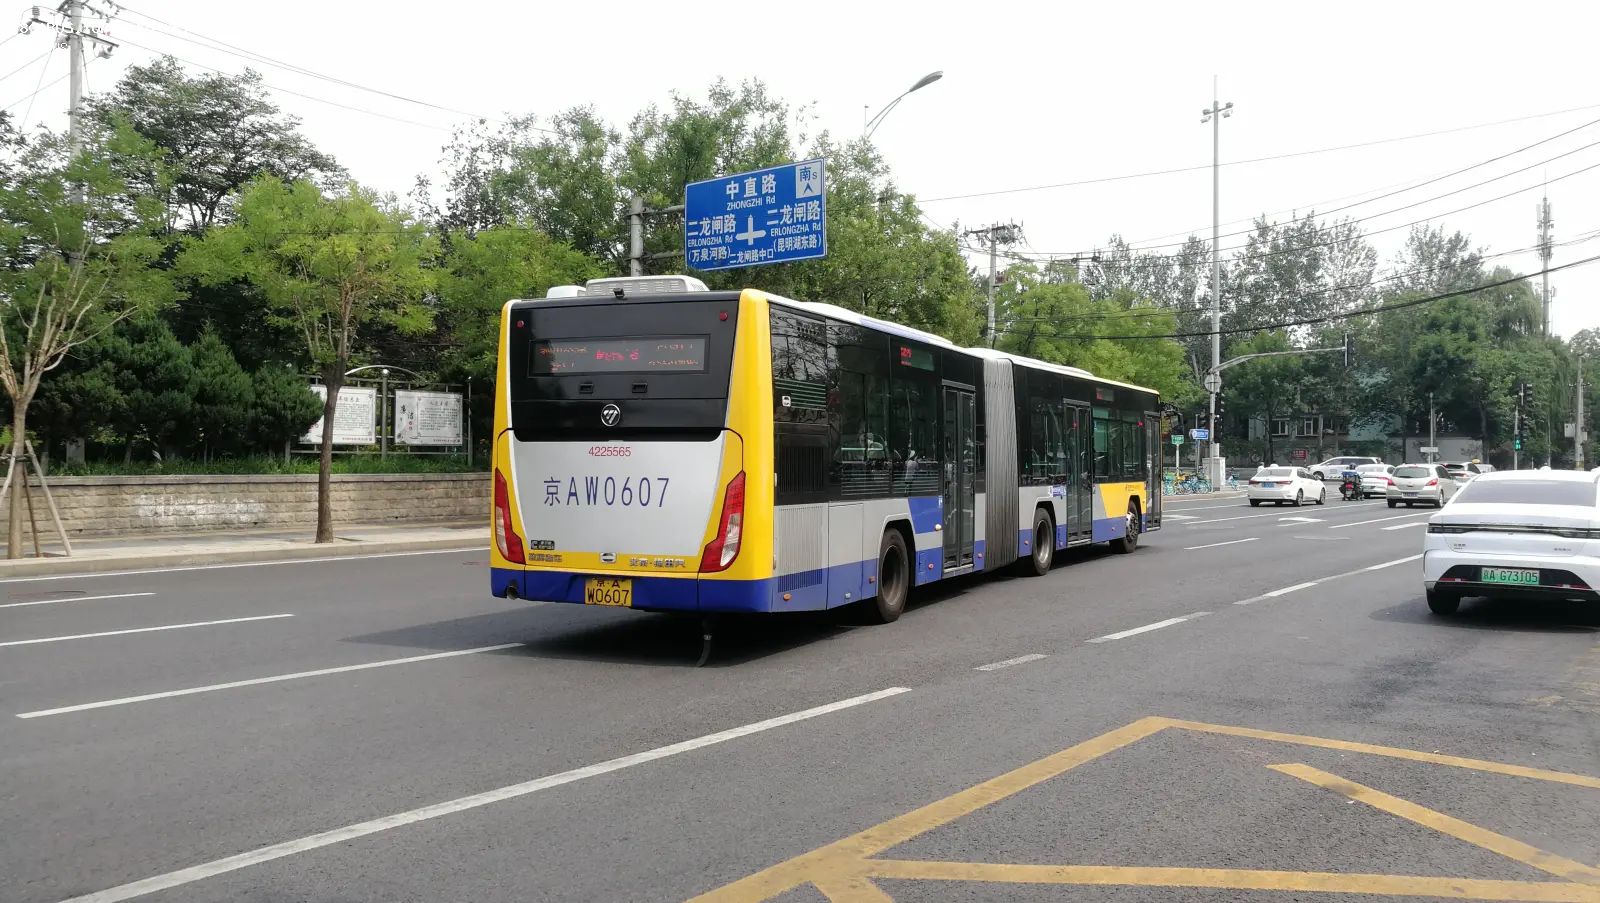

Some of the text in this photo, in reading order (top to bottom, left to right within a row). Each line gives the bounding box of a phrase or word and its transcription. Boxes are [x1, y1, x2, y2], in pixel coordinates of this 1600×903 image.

[799, 166, 811, 182] 南
[726, 173, 777, 200] 中直路
[726, 195, 776, 211] ZHONGZHI Rd
[767, 200, 821, 226] 二龙闸路
[687, 213, 737, 237] 二龙闸路
[771, 222, 821, 237] ERLONGZHA Rd
[688, 234, 733, 247] ERLONGZHA Rd
[588, 446, 632, 457] 4225565
[543, 476, 670, 508] 京AW0607
[1499, 570, 1539, 584] G73105
[587, 589, 630, 605] W0607
